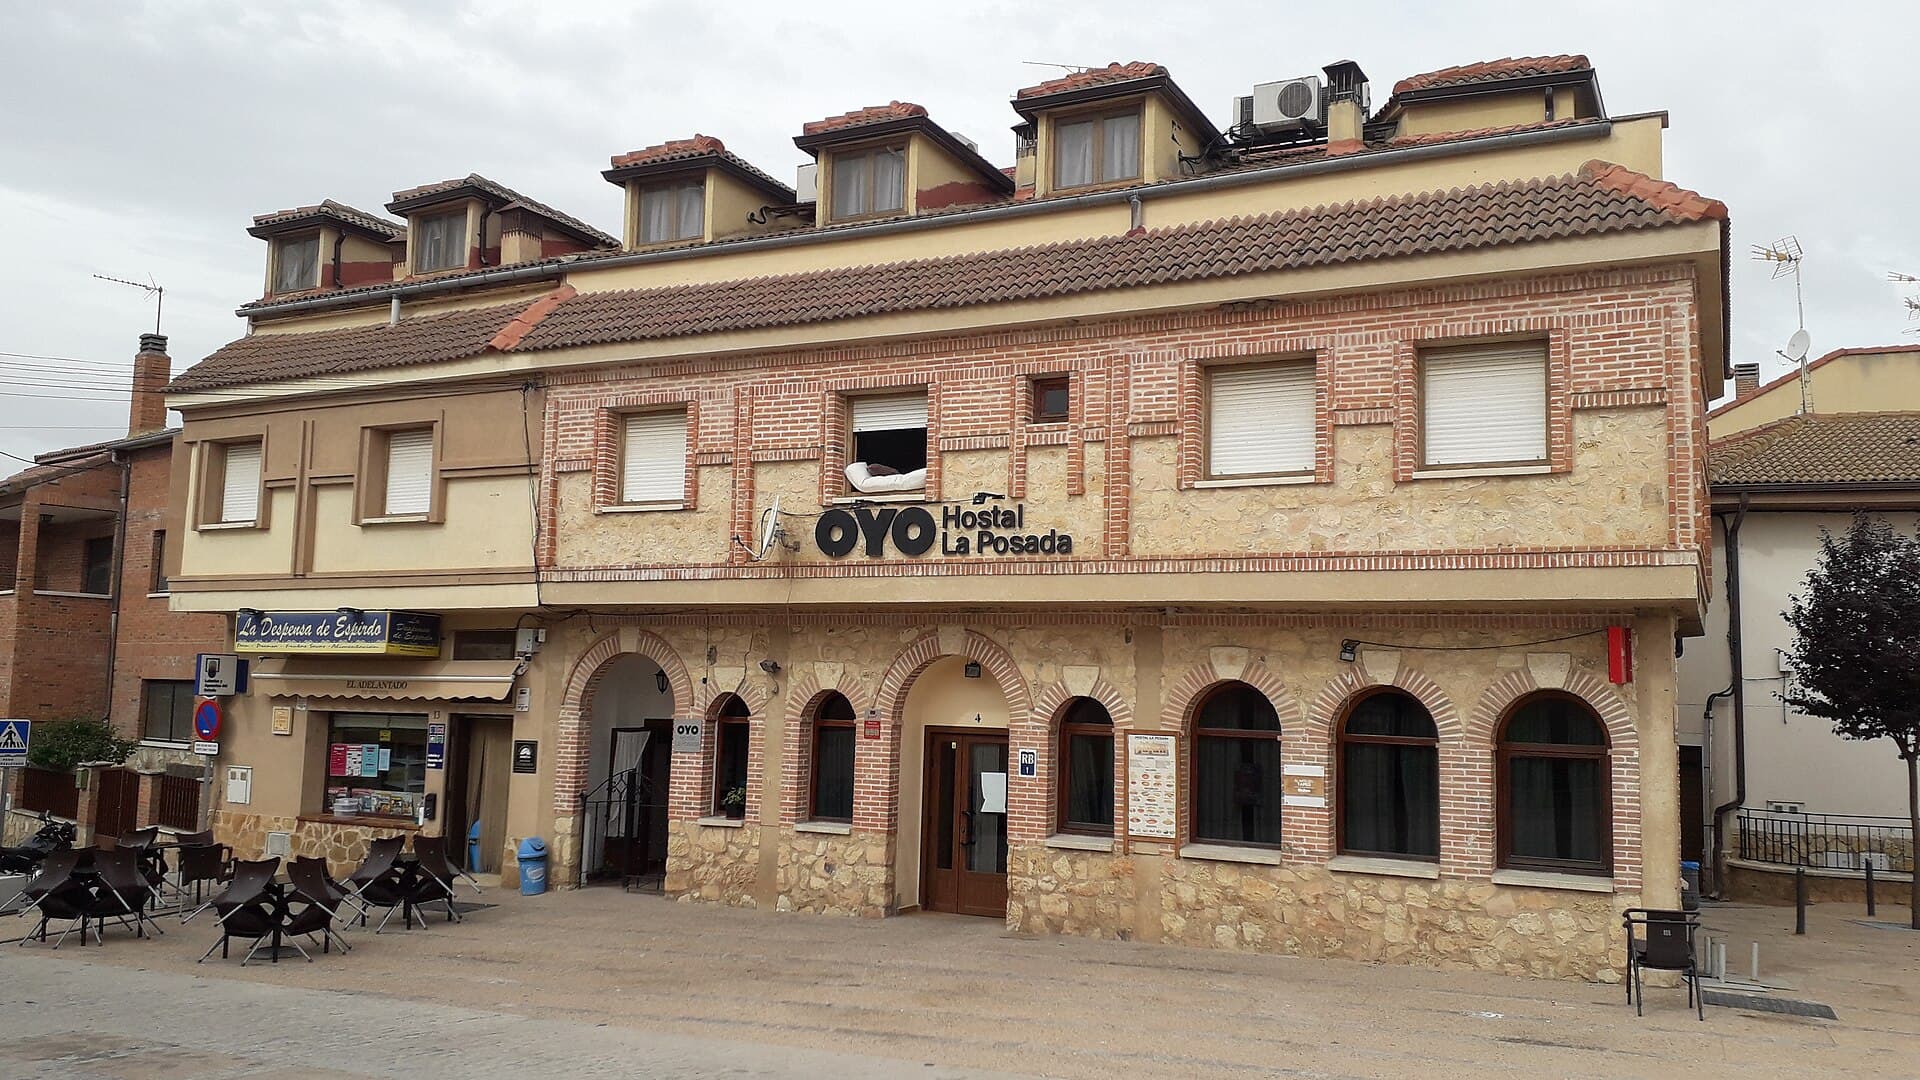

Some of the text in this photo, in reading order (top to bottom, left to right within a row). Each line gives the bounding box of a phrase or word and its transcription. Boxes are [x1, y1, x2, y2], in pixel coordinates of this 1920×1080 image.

[942, 504, 1024, 530] Hostal
[815, 507, 936, 557] OYO
[941, 529, 1073, 555] La Posada
[240, 618, 257, 636] La
[261, 617, 312, 640] Despensa
[316, 619, 330, 636] de
[334, 616, 382, 640] Espirdo
[346, 680, 408, 690] EL ADELANTADO
[974, 713, 981, 723] 4
[677, 725, 699, 735] OYO
[1021, 753, 1034, 765] RB
